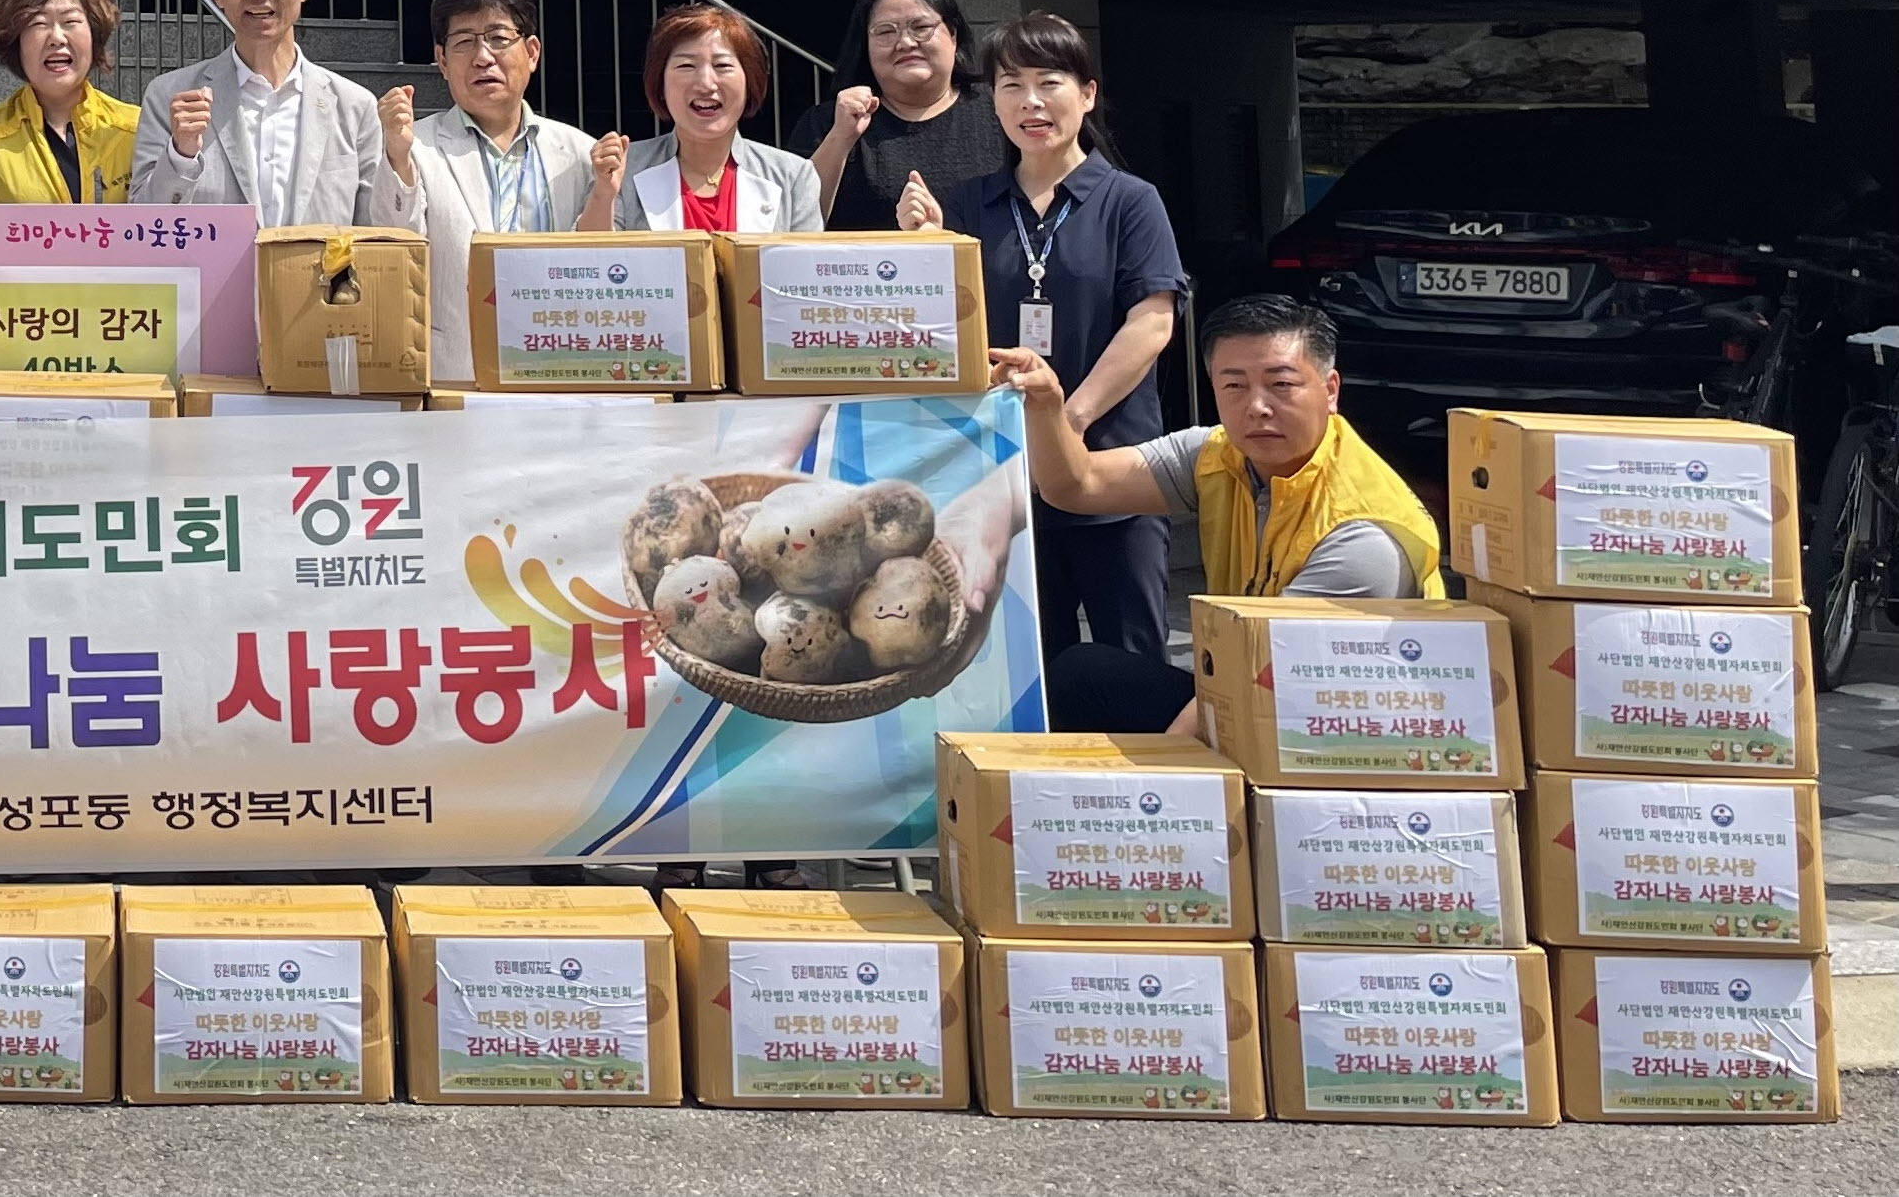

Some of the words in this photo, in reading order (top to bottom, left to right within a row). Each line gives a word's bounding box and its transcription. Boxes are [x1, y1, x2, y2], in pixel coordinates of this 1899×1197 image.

[124, 218, 217, 250] 이웃돕기
[1419, 266, 1488, 292] 336두
[1495, 269, 1561, 295] 7880
[100, 308, 162, 341] 감자
[532, 310, 580, 327] 따뜻한
[584, 309, 647, 327] 이웃사랑
[523, 333, 591, 352] 감자나눔
[595, 332, 664, 352] 사랑봉사
[790, 330, 860, 349] 감자나눔
[864, 329, 934, 349] 사랑봉사
[292, 459, 423, 545] 강원
[1589, 532, 1665, 556] 감자나눔
[1671, 535, 1747, 560] 사랑봉사
[294, 554, 426, 588] 특별자치도
[215, 619, 658, 747] 사랑봉사
[1622, 677, 1676, 700] 따뜻한
[1681, 680, 1753, 704] 이웃사랑
[1315, 689, 1370, 710] 따뜻한
[1374, 689, 1447, 711] 이웃사랑
[1305, 715, 1384, 737] 감자나눔
[1388, 716, 1467, 740] 사랑봉사
[1610, 703, 1688, 728] 감자나눔
[1694, 707, 1771, 733] 사랑봉사
[152, 785, 433, 830] 행정복지센터
[1055, 843, 1109, 863] 따뜻한
[1113, 843, 1185, 864] 이웃사랑
[1623, 852, 1679, 875] 따뜻한
[1684, 854, 1757, 878] 이웃사랑
[1046, 869, 1122, 891] 감자나눔
[1127, 869, 1204, 892] 사랑봉사
[1613, 879, 1692, 903] 감자나눔
[1697, 882, 1776, 907] 사랑봉사
[1313, 890, 1393, 912] 감자나눔
[1397, 890, 1476, 913] 사랑봉사
[195, 1013, 247, 1032] 따뜻한
[251, 1012, 320, 1032] 이웃사랑
[773, 1014, 826, 1034] 따뜻한
[830, 1014, 900, 1035] 이웃사랑
[185, 1039, 258, 1060] 감자나눔
[263, 1038, 337, 1060] 사랑봉사
[466, 1035, 541, 1057] 감자나눔
[546, 1036, 621, 1059] 사랑봉사
[1053, 1025, 1108, 1047] 따뜻한
[1112, 1026, 1184, 1048] 이웃사랑
[1343, 1025, 1399, 1047] 따뜻한
[1403, 1026, 1478, 1048] 이웃사랑
[763, 1041, 838, 1062] 감자나눔
[843, 1040, 918, 1063] 사랑봉사
[1043, 1052, 1121, 1075] 감자나눔
[1126, 1053, 1204, 1077] 사랑봉사
[1333, 1052, 1414, 1075] 감자나눔
[1418, 1053, 1498, 1077] 사랑봉사
